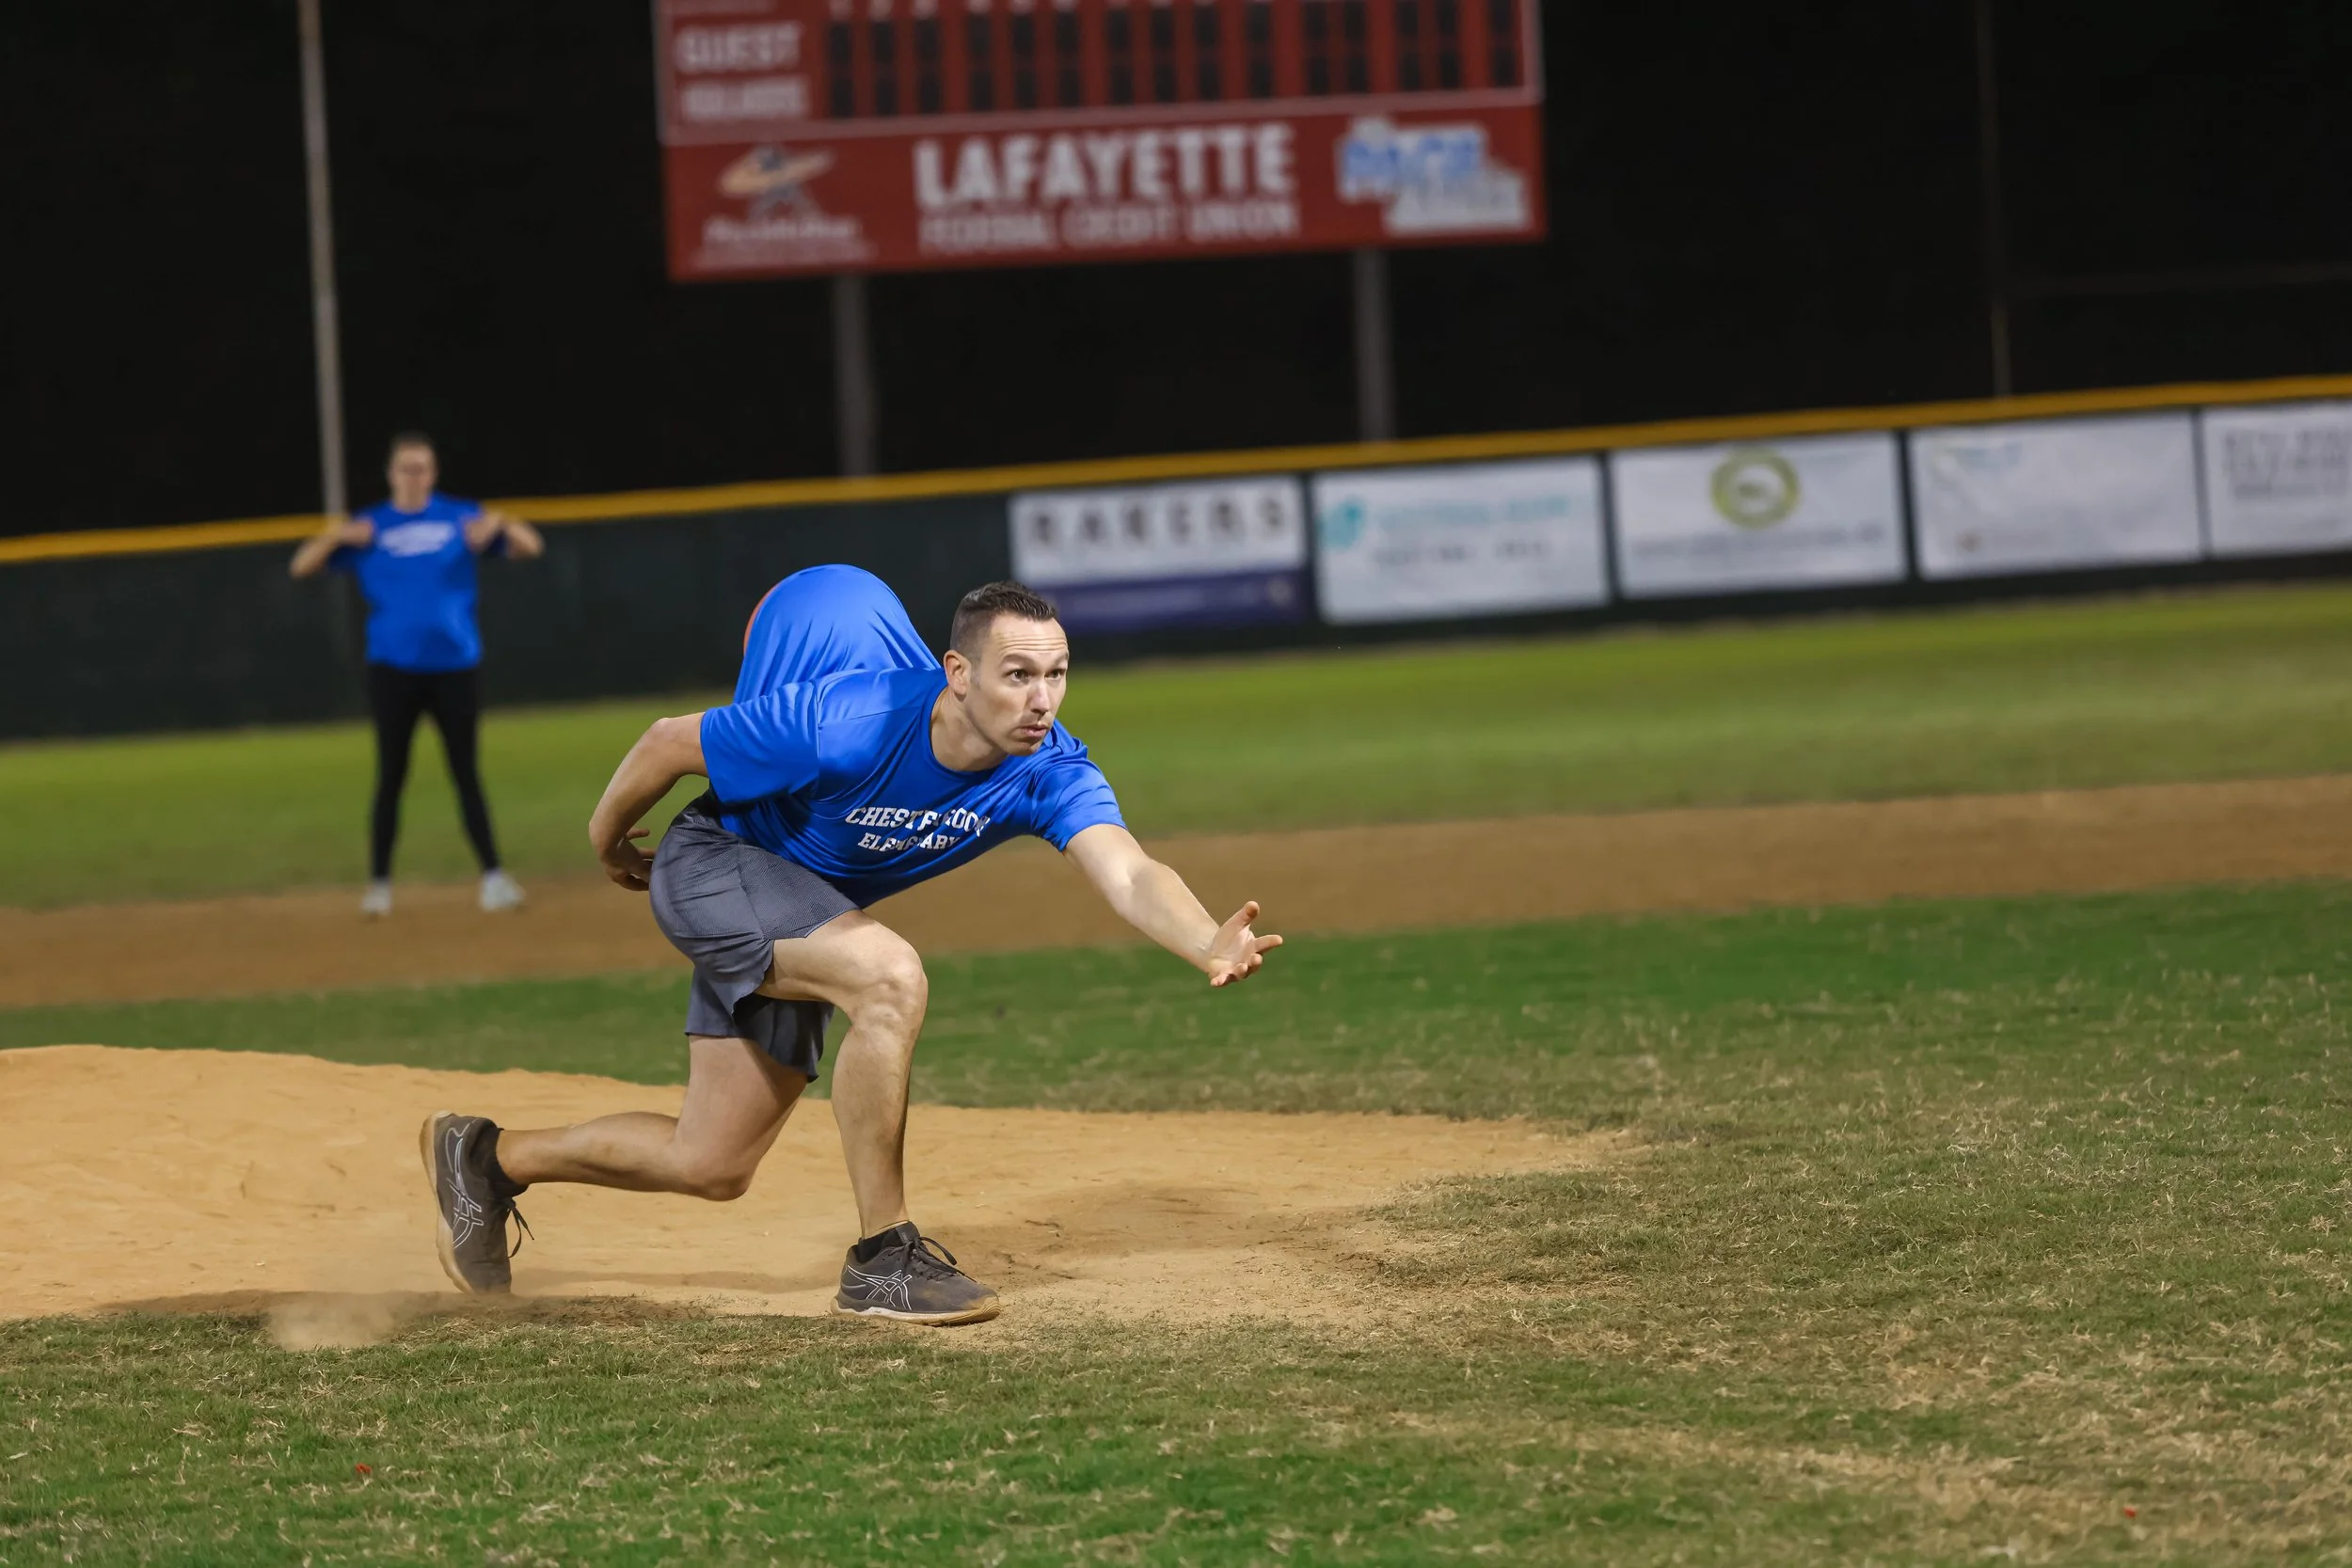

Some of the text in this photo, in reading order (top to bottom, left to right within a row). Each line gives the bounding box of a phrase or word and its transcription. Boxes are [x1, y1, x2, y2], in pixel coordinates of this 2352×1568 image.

[676, 23, 802, 72] GUEST
[914, 124, 1296, 209] LAFAYETTE
[1188, 199, 1298, 243] UNION
